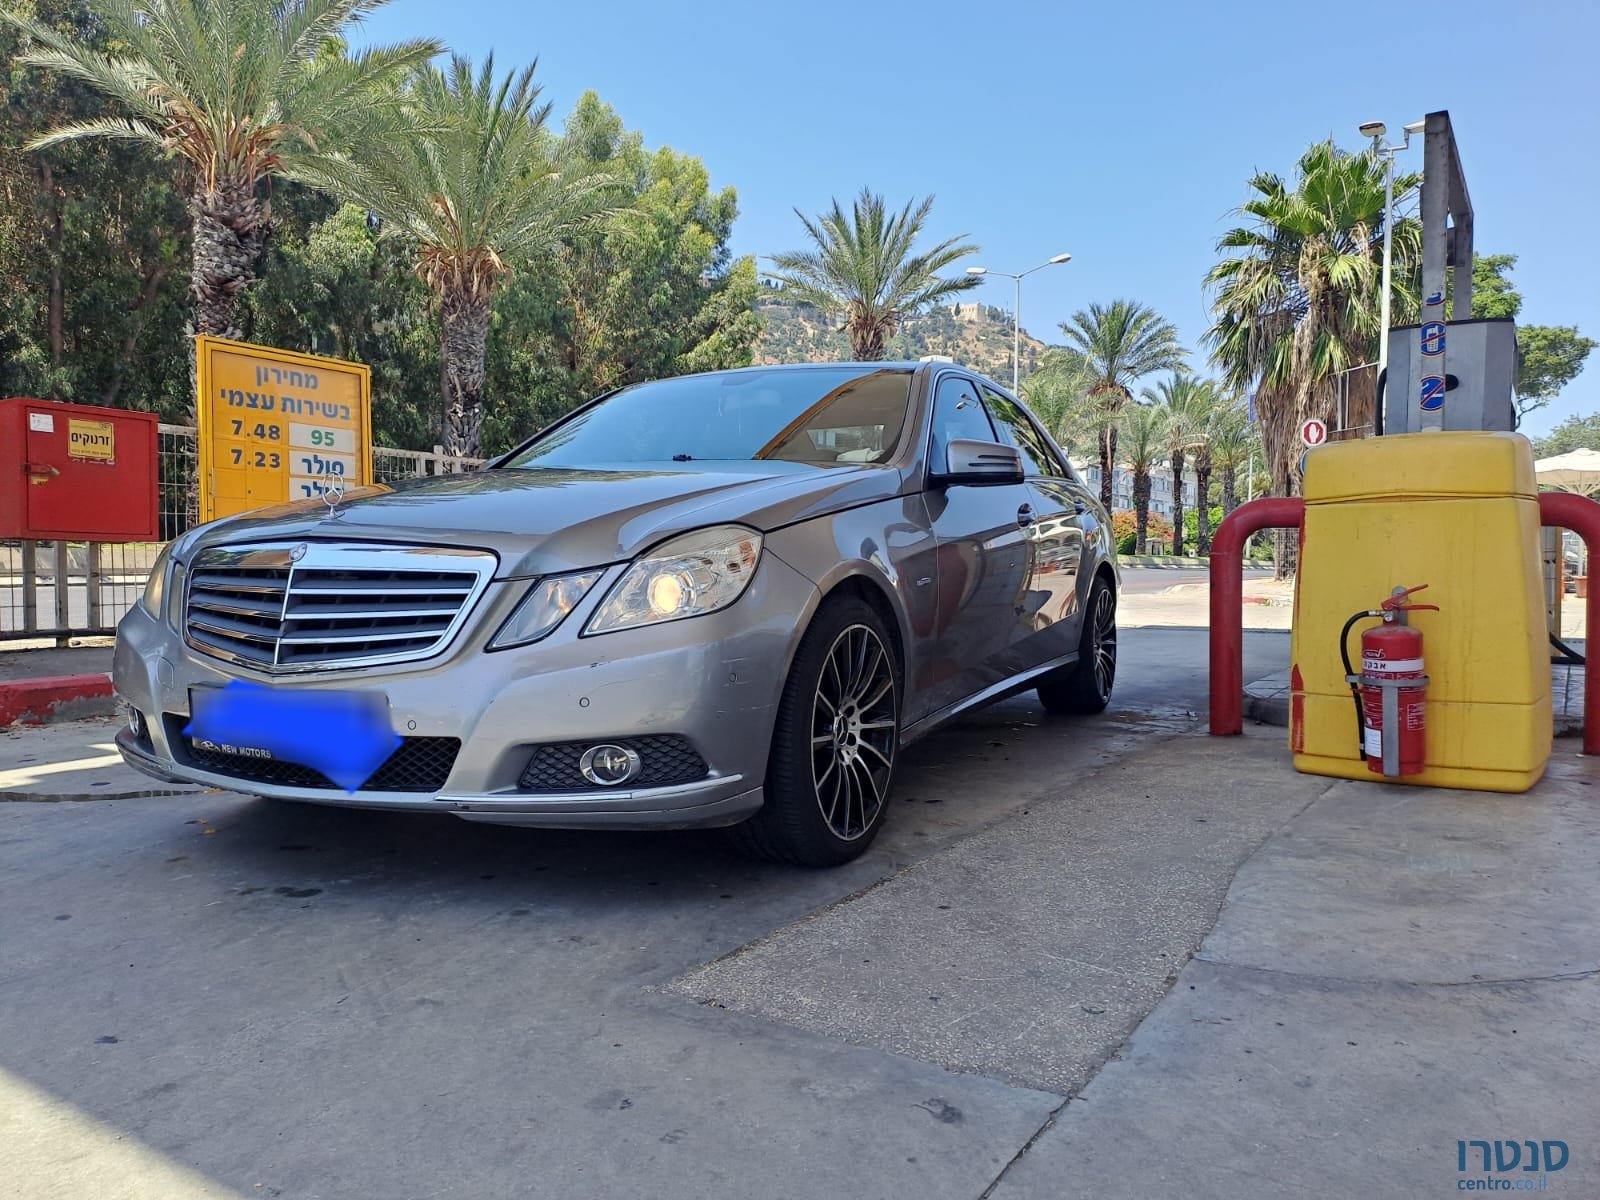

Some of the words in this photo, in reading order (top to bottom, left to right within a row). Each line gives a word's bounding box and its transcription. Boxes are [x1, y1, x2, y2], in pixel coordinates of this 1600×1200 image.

[256, 366, 319, 390] מחירון
[220, 388, 275, 410] עצמי
[281, 396, 351, 420] בשירות
[71, 432, 110, 447] זרנוקים
[231, 419, 281, 440] 7.48
[311, 429, 335, 447] 95
[231, 448, 281, 469] 7.23
[301, 454, 345, 476] פולר
[221, 744, 238, 755] NEW
[239, 746, 272, 759] MOTORS
